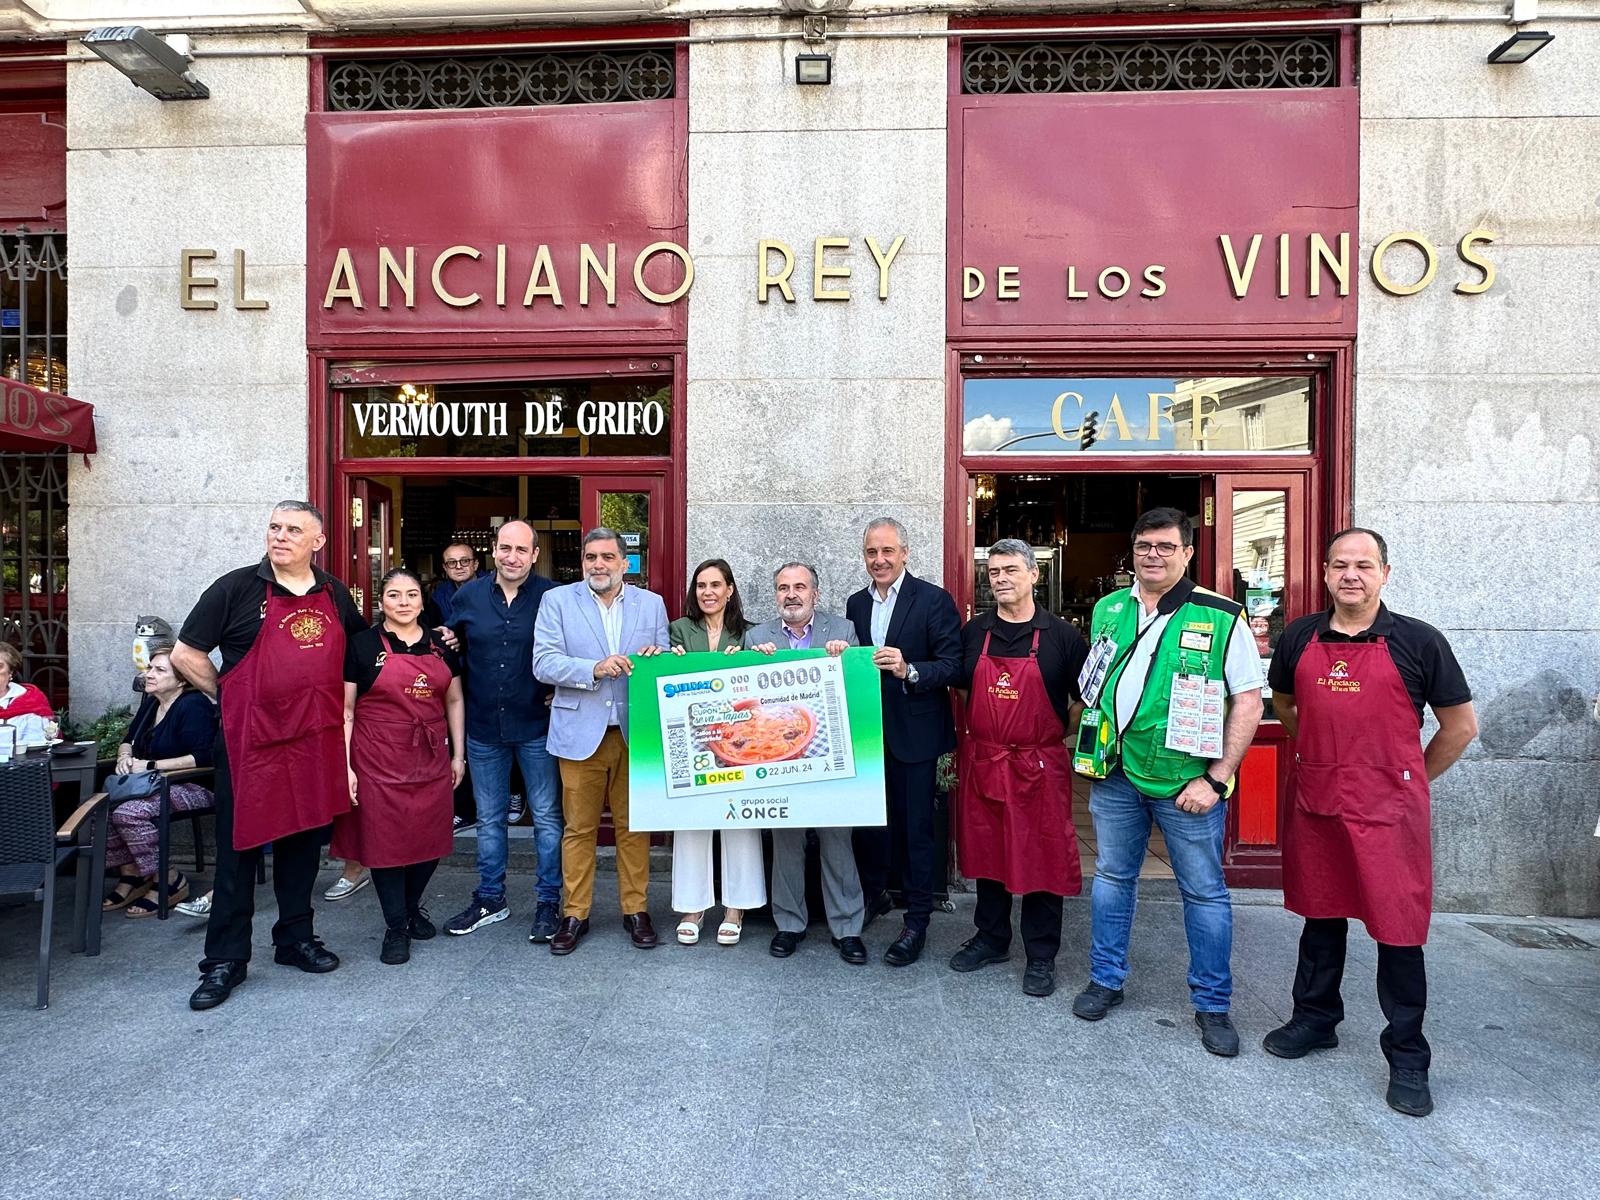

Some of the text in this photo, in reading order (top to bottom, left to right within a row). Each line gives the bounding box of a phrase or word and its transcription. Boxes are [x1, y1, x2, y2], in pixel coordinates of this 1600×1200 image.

[180, 229, 1499, 310] EL ANCIANO REY DE LOS VINOS
[352, 401, 664, 438] VERMOUTH DE GRIFO
[1050, 391, 1223, 442] CAFE
[730, 666, 822, 690] 000 00000
[1328, 678, 1361, 686] Anciano
[760, 691, 820, 705] Comunidad de Madrid
[768, 767, 779, 776] 22
[802, 763, 813, 772] 24
[708, 771, 743, 783] ONCE
[741, 796, 789, 806] grupo social
[741, 806, 789, 819] ONCE
